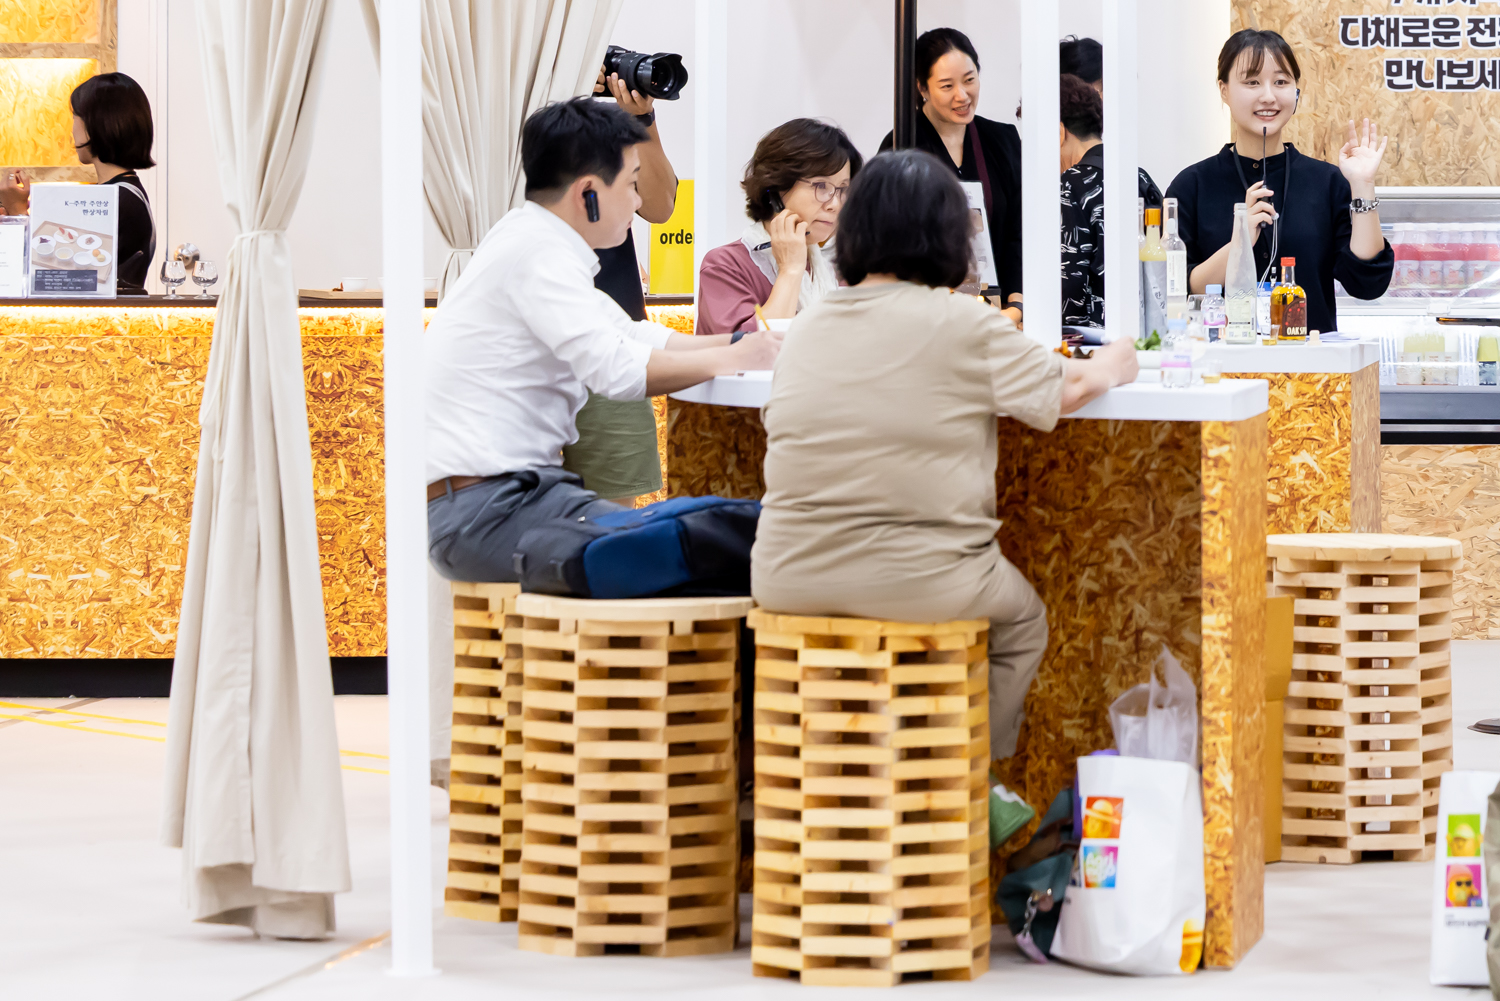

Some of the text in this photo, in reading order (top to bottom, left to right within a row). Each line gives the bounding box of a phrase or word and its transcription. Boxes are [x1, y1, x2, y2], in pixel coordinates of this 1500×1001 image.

[1340, 16, 1461, 48] 다채로운
[659, 228, 694, 245] orde
[1286, 326, 1299, 336] OAK
